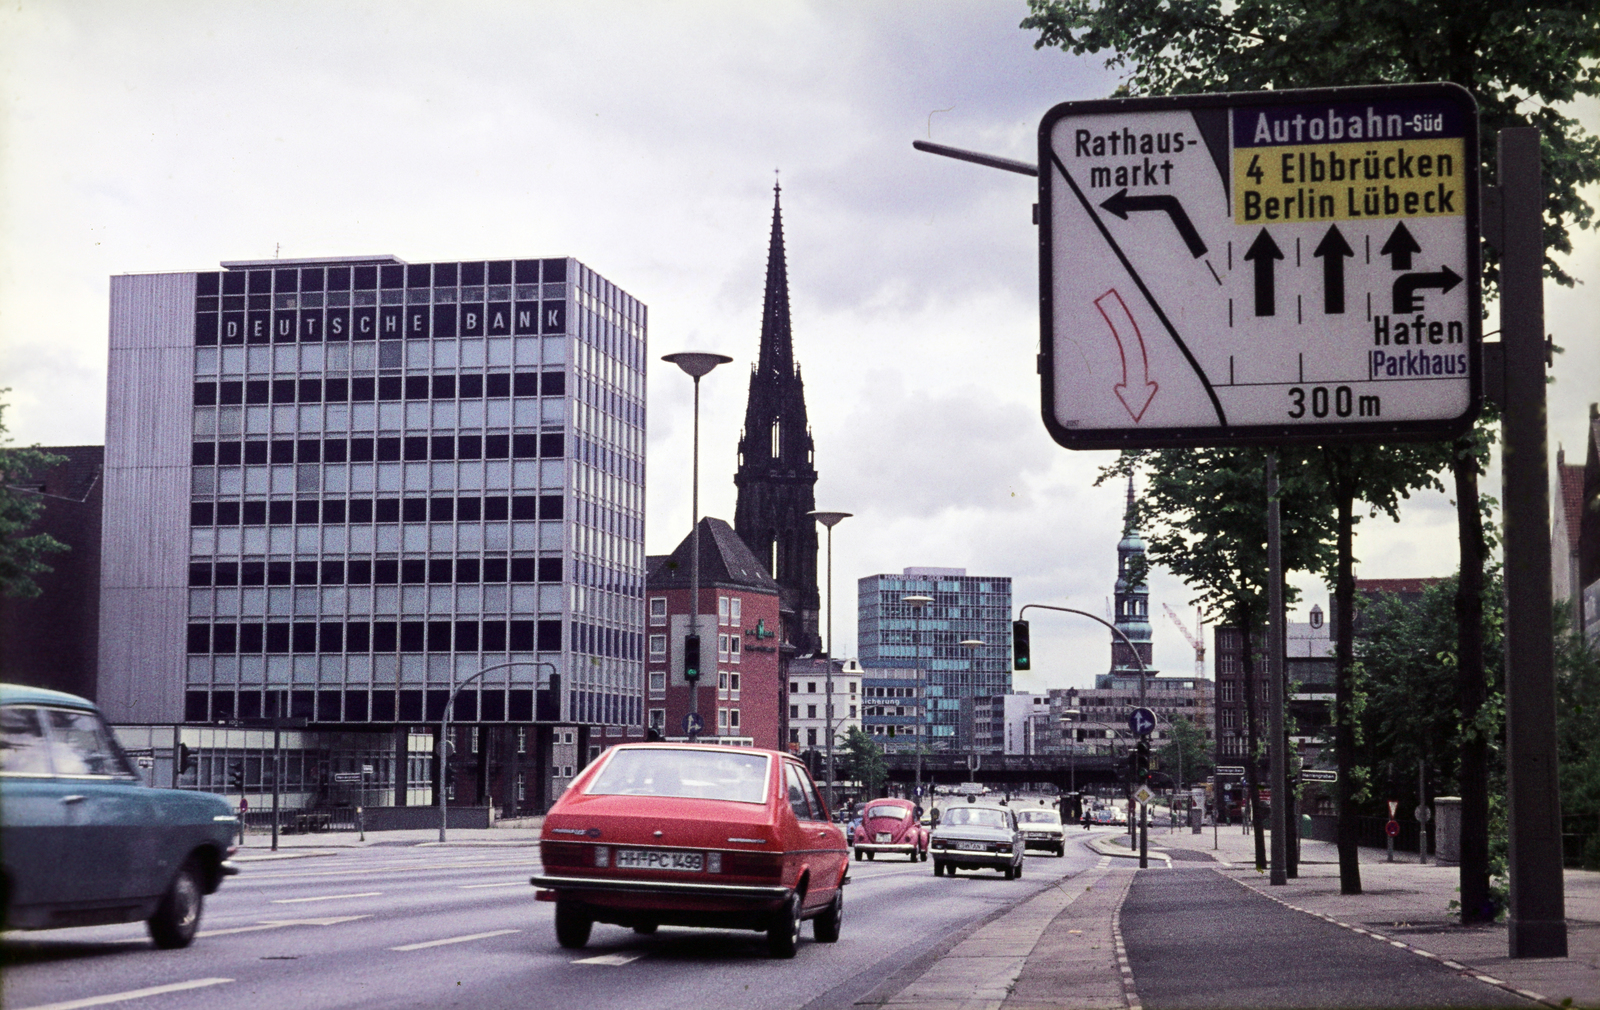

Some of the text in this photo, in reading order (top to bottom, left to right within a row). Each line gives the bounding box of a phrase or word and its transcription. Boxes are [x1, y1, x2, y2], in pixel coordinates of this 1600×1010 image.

[1076, 127, 1198, 157] Rathaus-
[1091, 157, 1174, 188] markt
[1246, 148, 1453, 185] 4 Elbbrücken
[1244, 183, 1455, 221] Berlin Lübeck
[226, 309, 559, 338] DEUTSCHE BANK
[1374, 314, 1463, 346] Hafen
[1373, 349, 1467, 376] Parkhaus
[672, 854, 701, 870] 1499
